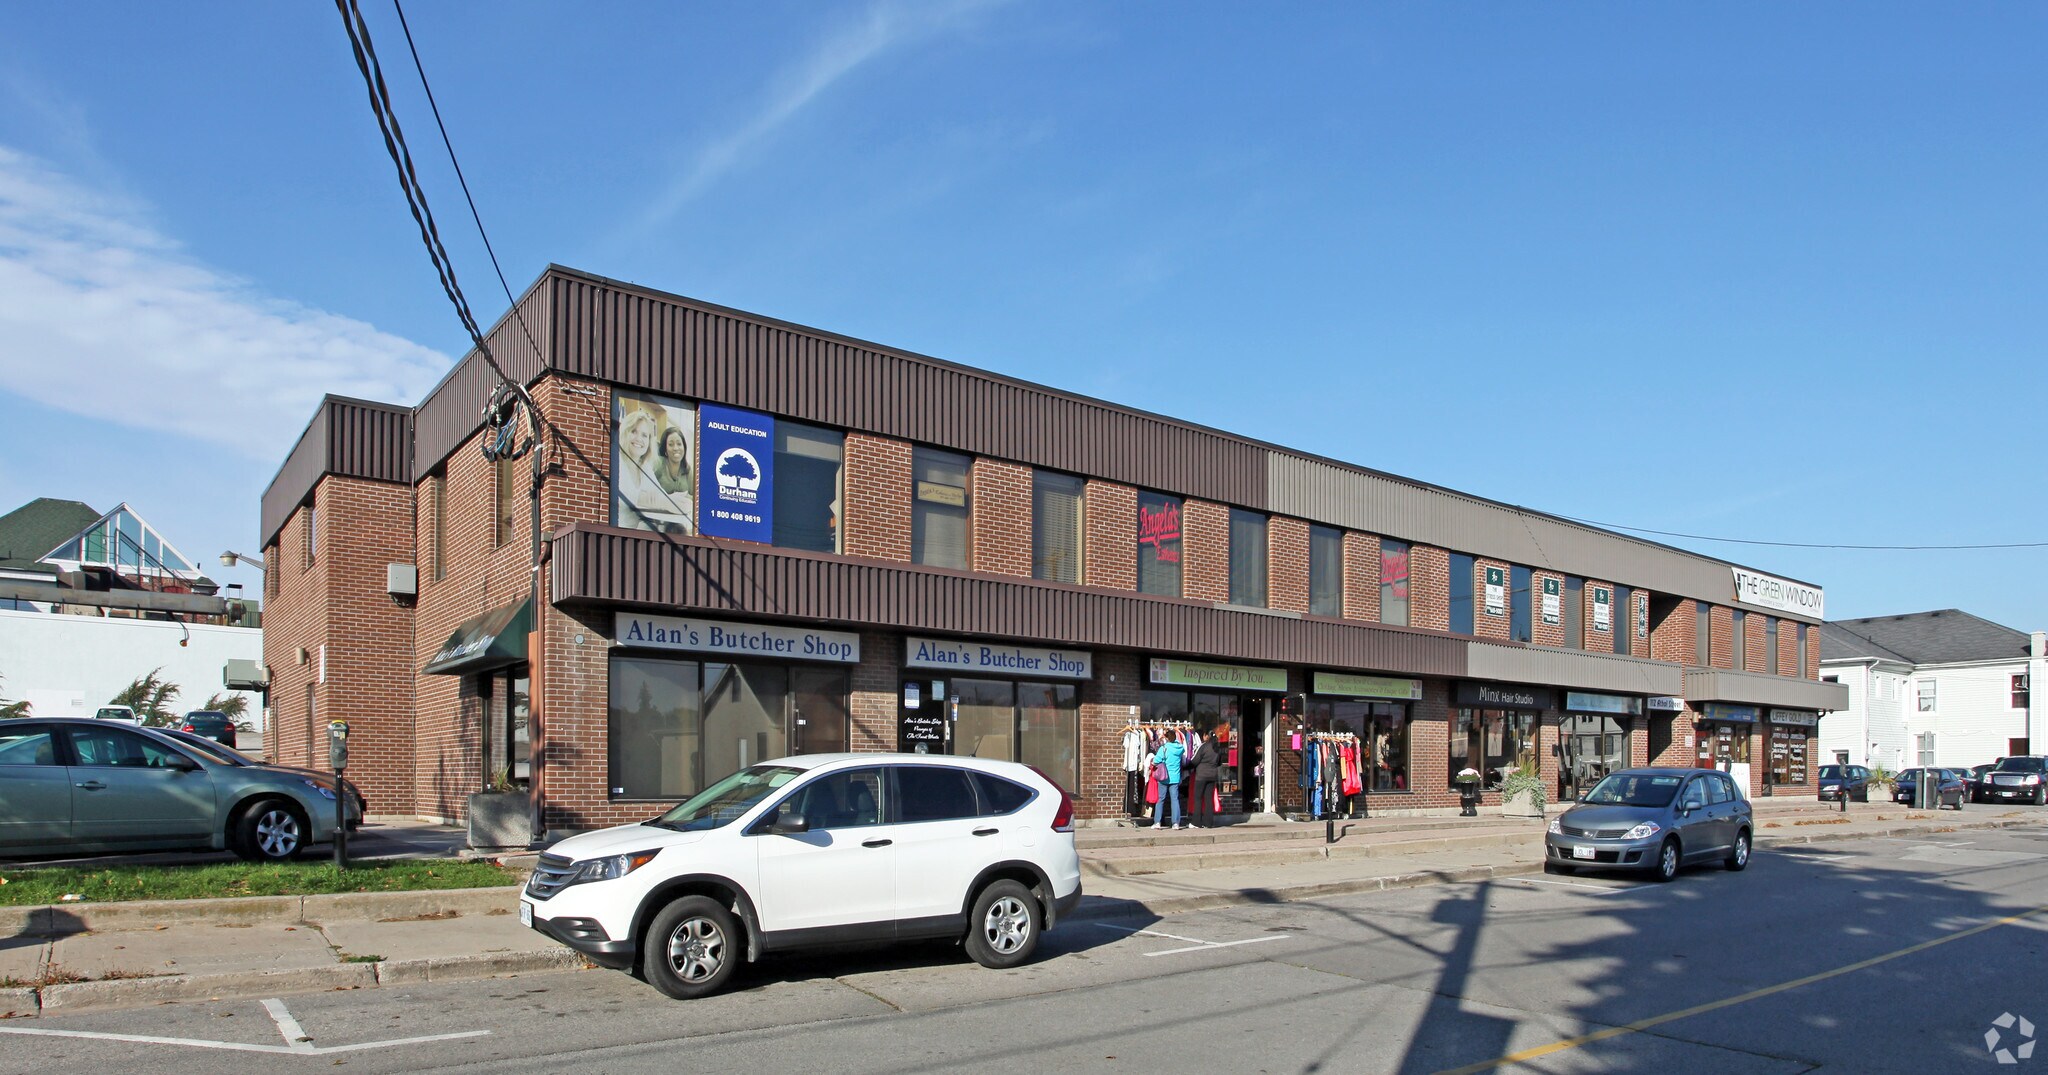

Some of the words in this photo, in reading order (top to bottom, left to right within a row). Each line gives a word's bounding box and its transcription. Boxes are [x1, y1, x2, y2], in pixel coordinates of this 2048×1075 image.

[708, 421, 730, 431] ADULT
[730, 425, 767, 438] EDUCATION
[719, 485, 757, 499] Durham
[716, 510, 729, 519] 800
[730, 512, 743, 521] 408
[744, 514, 761, 524] 9619
[1140, 501, 1179, 547] Angela's
[1741, 573, 1758, 595] THE
[1759, 578, 1785, 600] GREEN
[1785, 584, 1823, 609] WINDOW
[626, 619, 699, 646] Alan's
[709, 626, 795, 653] Butcher
[803, 634, 852, 660] Shop
[915, 641, 971, 664] Alan's
[979, 647, 1041, 670] Butcher
[1048, 652, 1085, 676] Shop
[1183, 664, 1229, 685] Inspired
[1230, 668, 1243, 686] By
[1479, 686, 1500, 702] Minx
[1501, 692, 1515, 703] Hair
[1515, 693, 1534, 705] Studio
[1657, 699, 1668, 707] Athol
[1772, 711, 1788, 722] LIFFEY
[1788, 713, 1802, 723] GOLD
